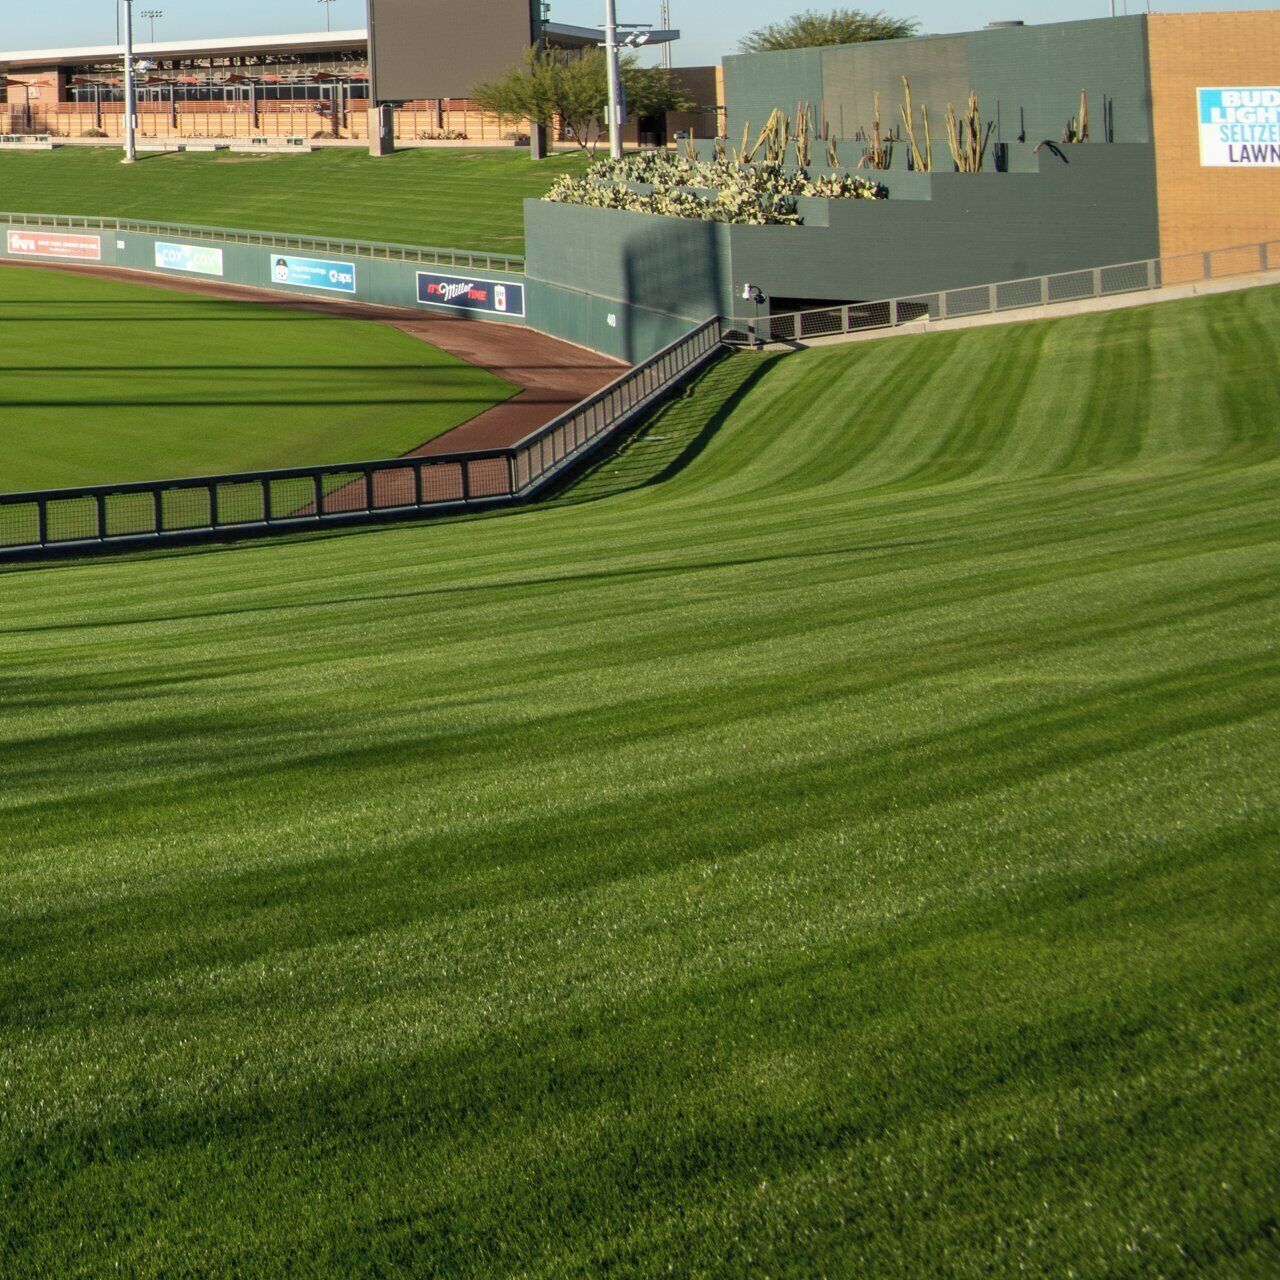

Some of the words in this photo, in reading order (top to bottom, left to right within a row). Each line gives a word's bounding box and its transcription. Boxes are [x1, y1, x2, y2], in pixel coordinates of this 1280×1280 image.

[1221, 90, 1280, 107] BUD
[1211, 106, 1280, 123] LIGH
[1220, 125, 1280, 142] SELTZE
[1228, 144, 1280, 162] LAWN
[163, 249, 183, 262] COX
[338, 273, 352, 283] aps
[439, 283, 474, 301] Miller
[467, 289, 487, 302] TIME
